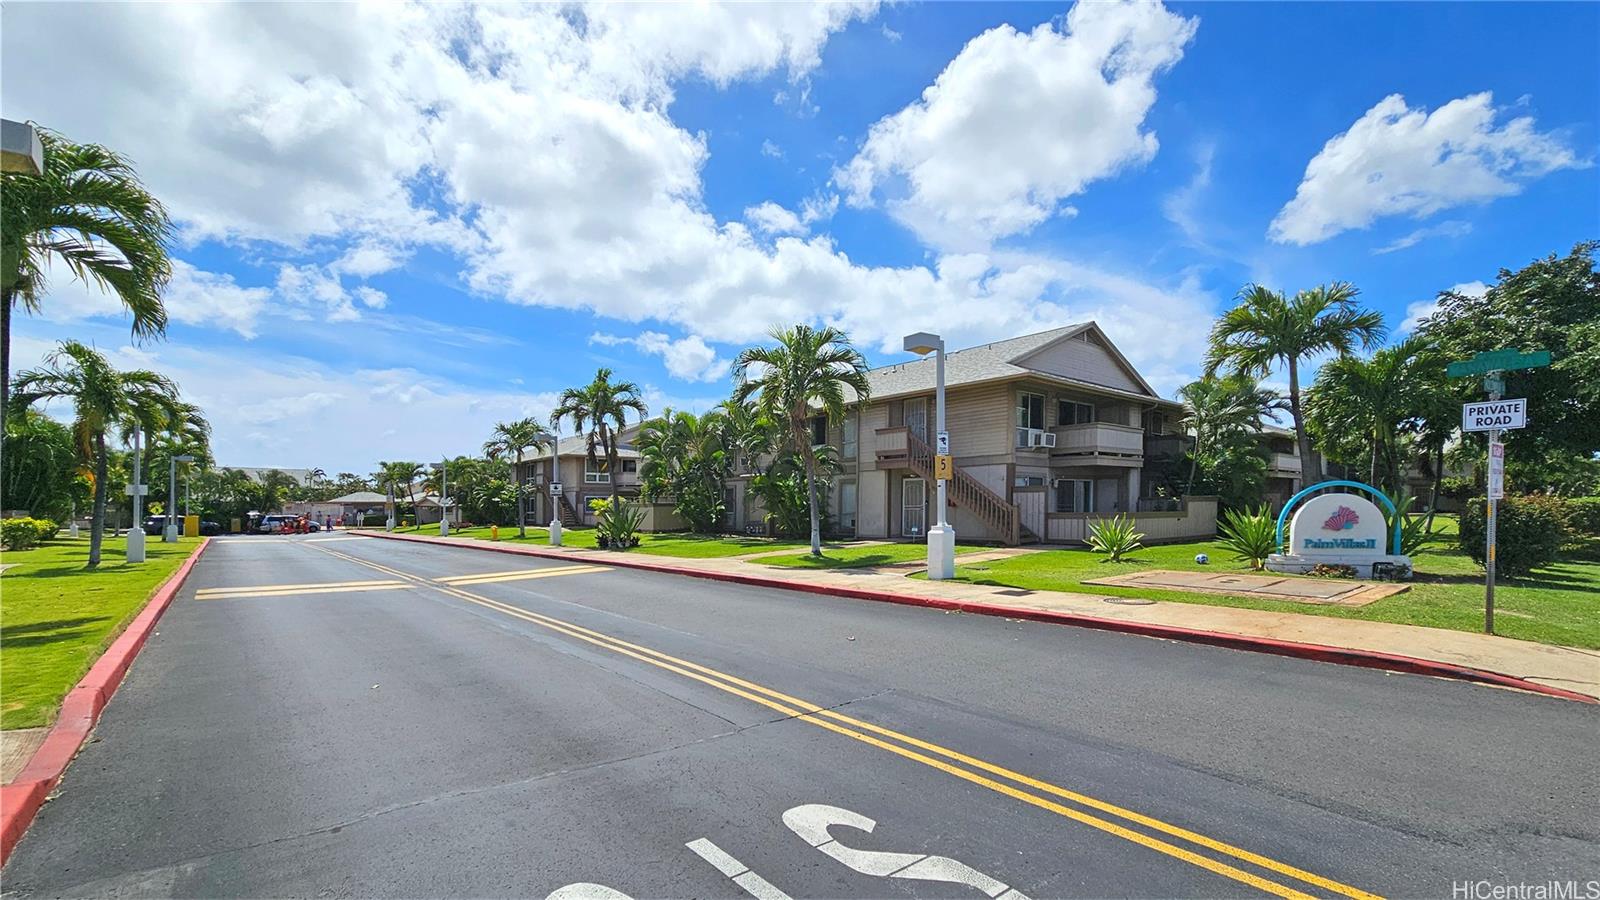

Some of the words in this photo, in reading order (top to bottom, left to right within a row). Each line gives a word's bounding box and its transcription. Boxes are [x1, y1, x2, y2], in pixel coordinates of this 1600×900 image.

[1469, 403, 1520, 416] PRIVATE
[1476, 416, 1512, 427] ROAD
[941, 458, 946, 471] 5
